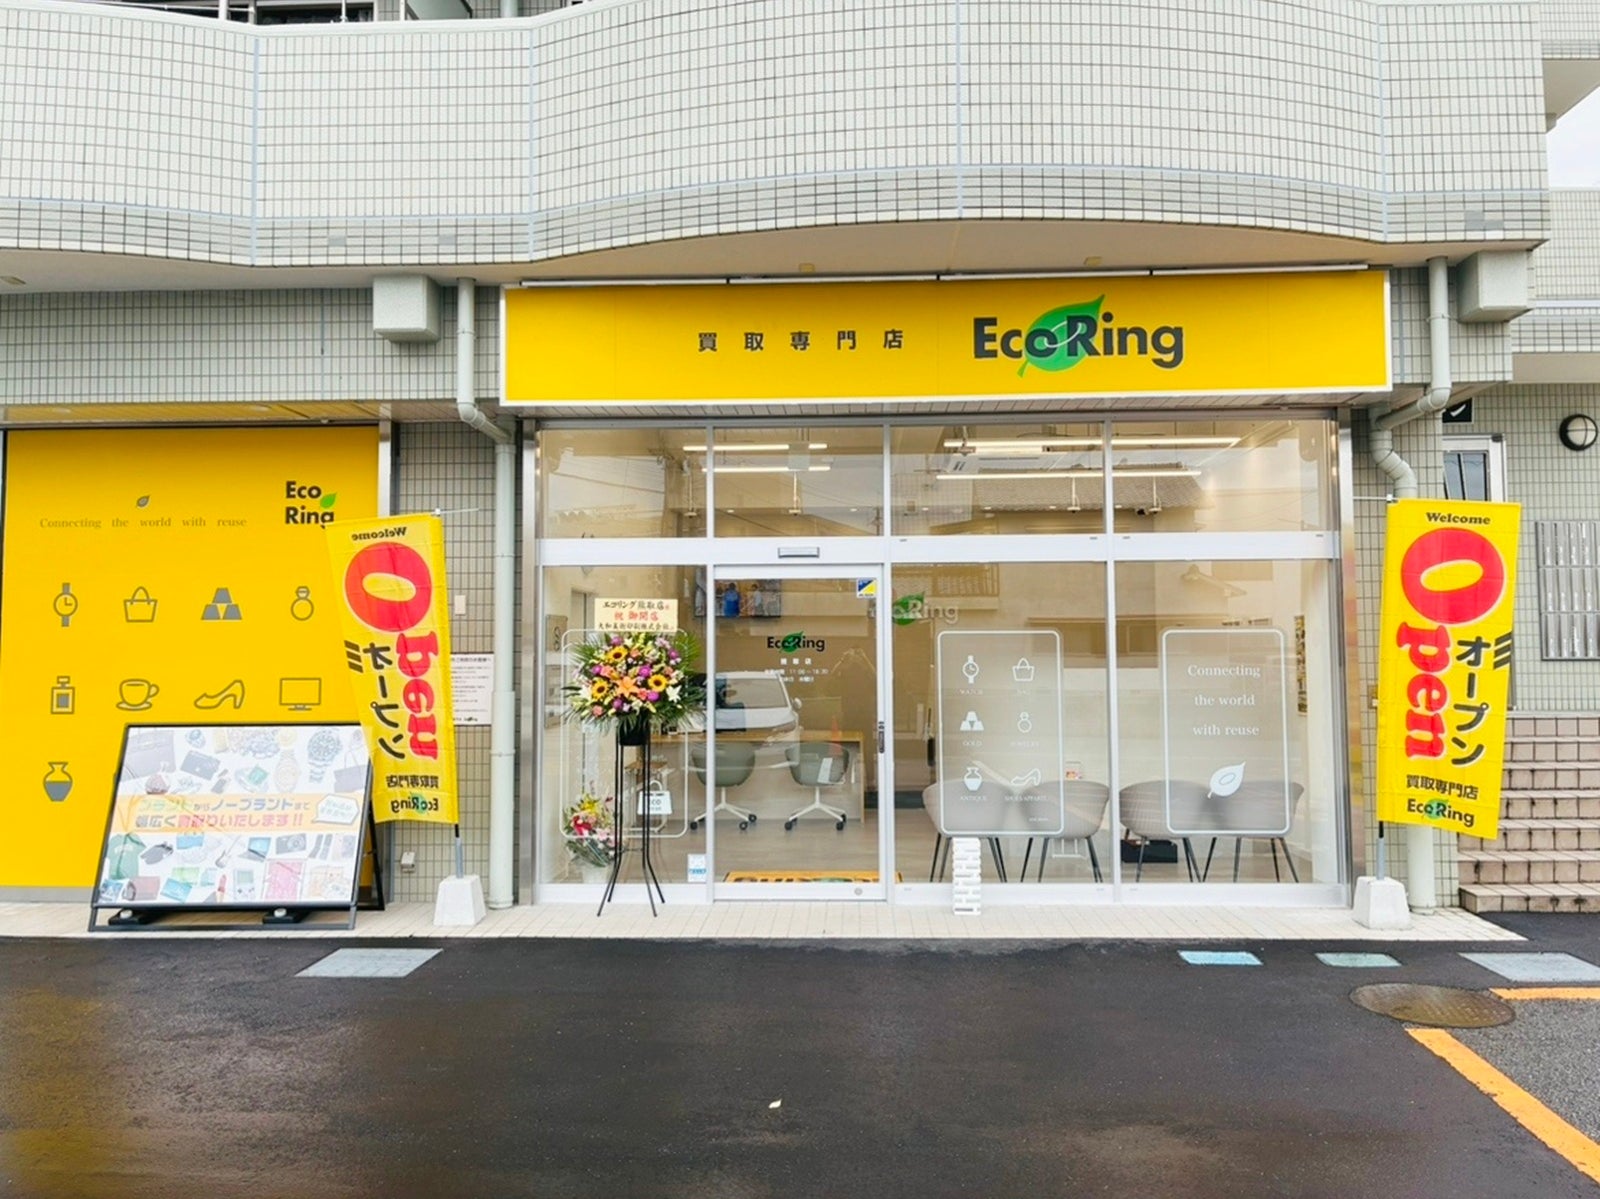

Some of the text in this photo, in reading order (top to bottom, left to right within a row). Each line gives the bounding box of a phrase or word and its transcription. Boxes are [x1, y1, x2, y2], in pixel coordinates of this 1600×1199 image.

[698, 329, 904, 352] 買取専門店
[285, 481, 322, 499] Eco
[39, 516, 247, 529] Connecting the world with reuse
[285, 505, 335, 529] Ring
[1425, 511, 1492, 525] Welcome
[1396, 526, 1506, 758] Open
[1187, 664, 1262, 679] Connecting
[1194, 694, 1256, 706] the world
[1450, 636, 1492, 766] オープン
[1192, 723, 1260, 736] with reuse
[1406, 774, 1480, 800] 買取専門店
